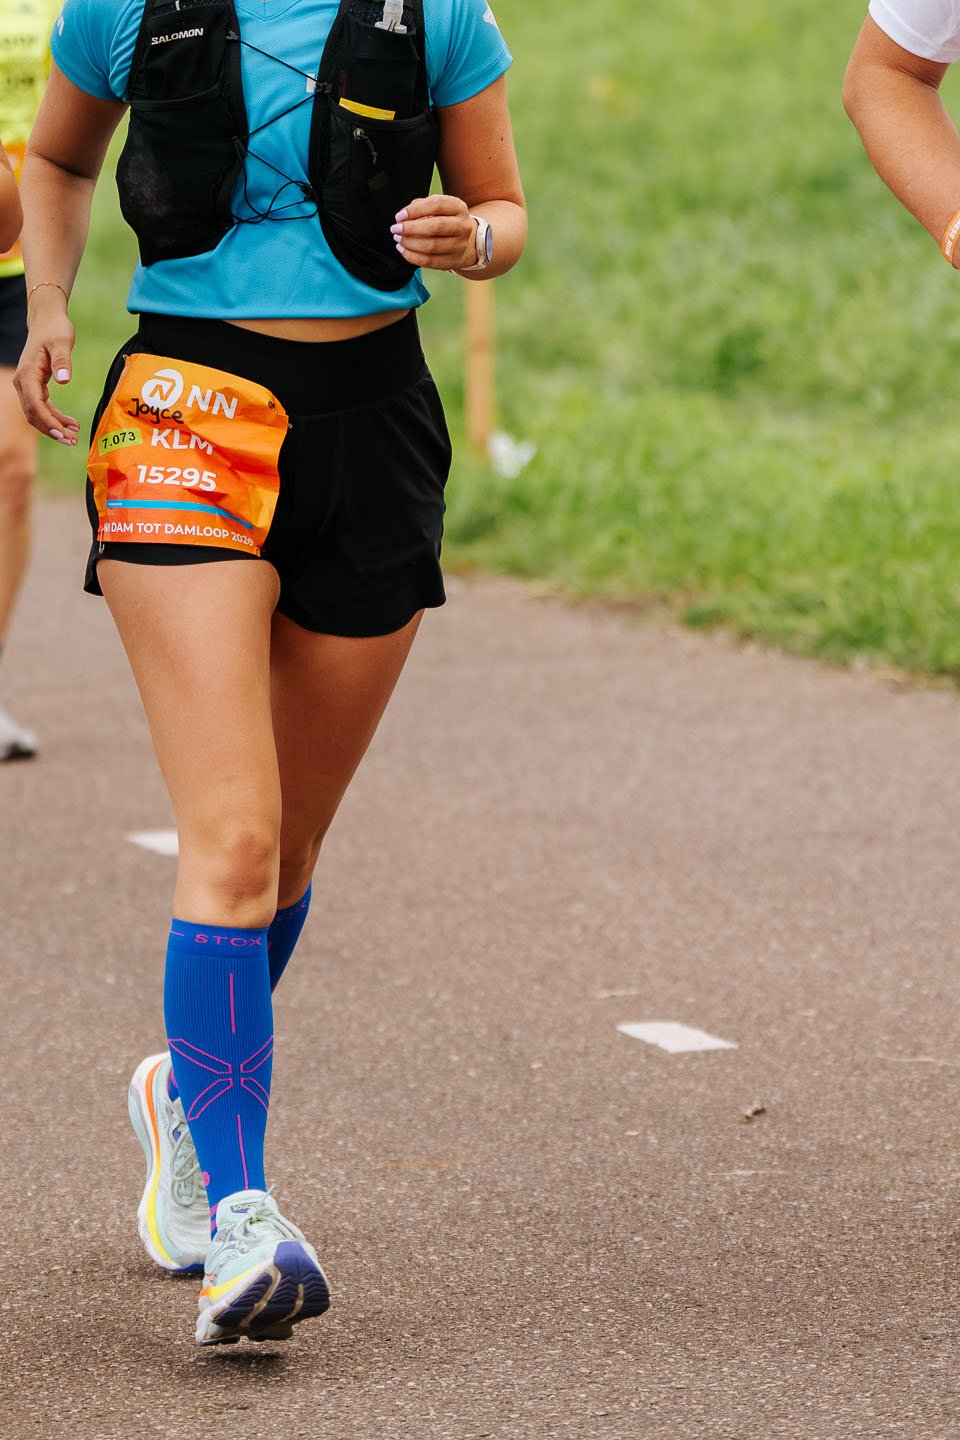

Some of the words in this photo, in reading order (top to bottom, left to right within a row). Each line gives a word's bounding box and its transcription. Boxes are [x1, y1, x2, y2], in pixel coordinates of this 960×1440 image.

[151, 28, 204, 46] SALOMON
[128, 398, 184, 424] Joyce
[186, 385, 238, 420] NN
[102, 431, 136, 449] 7.073
[150, 428, 215, 455] KLM
[136, 464, 217, 492] 15295
[112, 522, 133, 533] DAM
[136, 522, 161, 534] TOT
[164, 522, 229, 539] DAMLOOP
[194, 933, 263, 947] STOX
